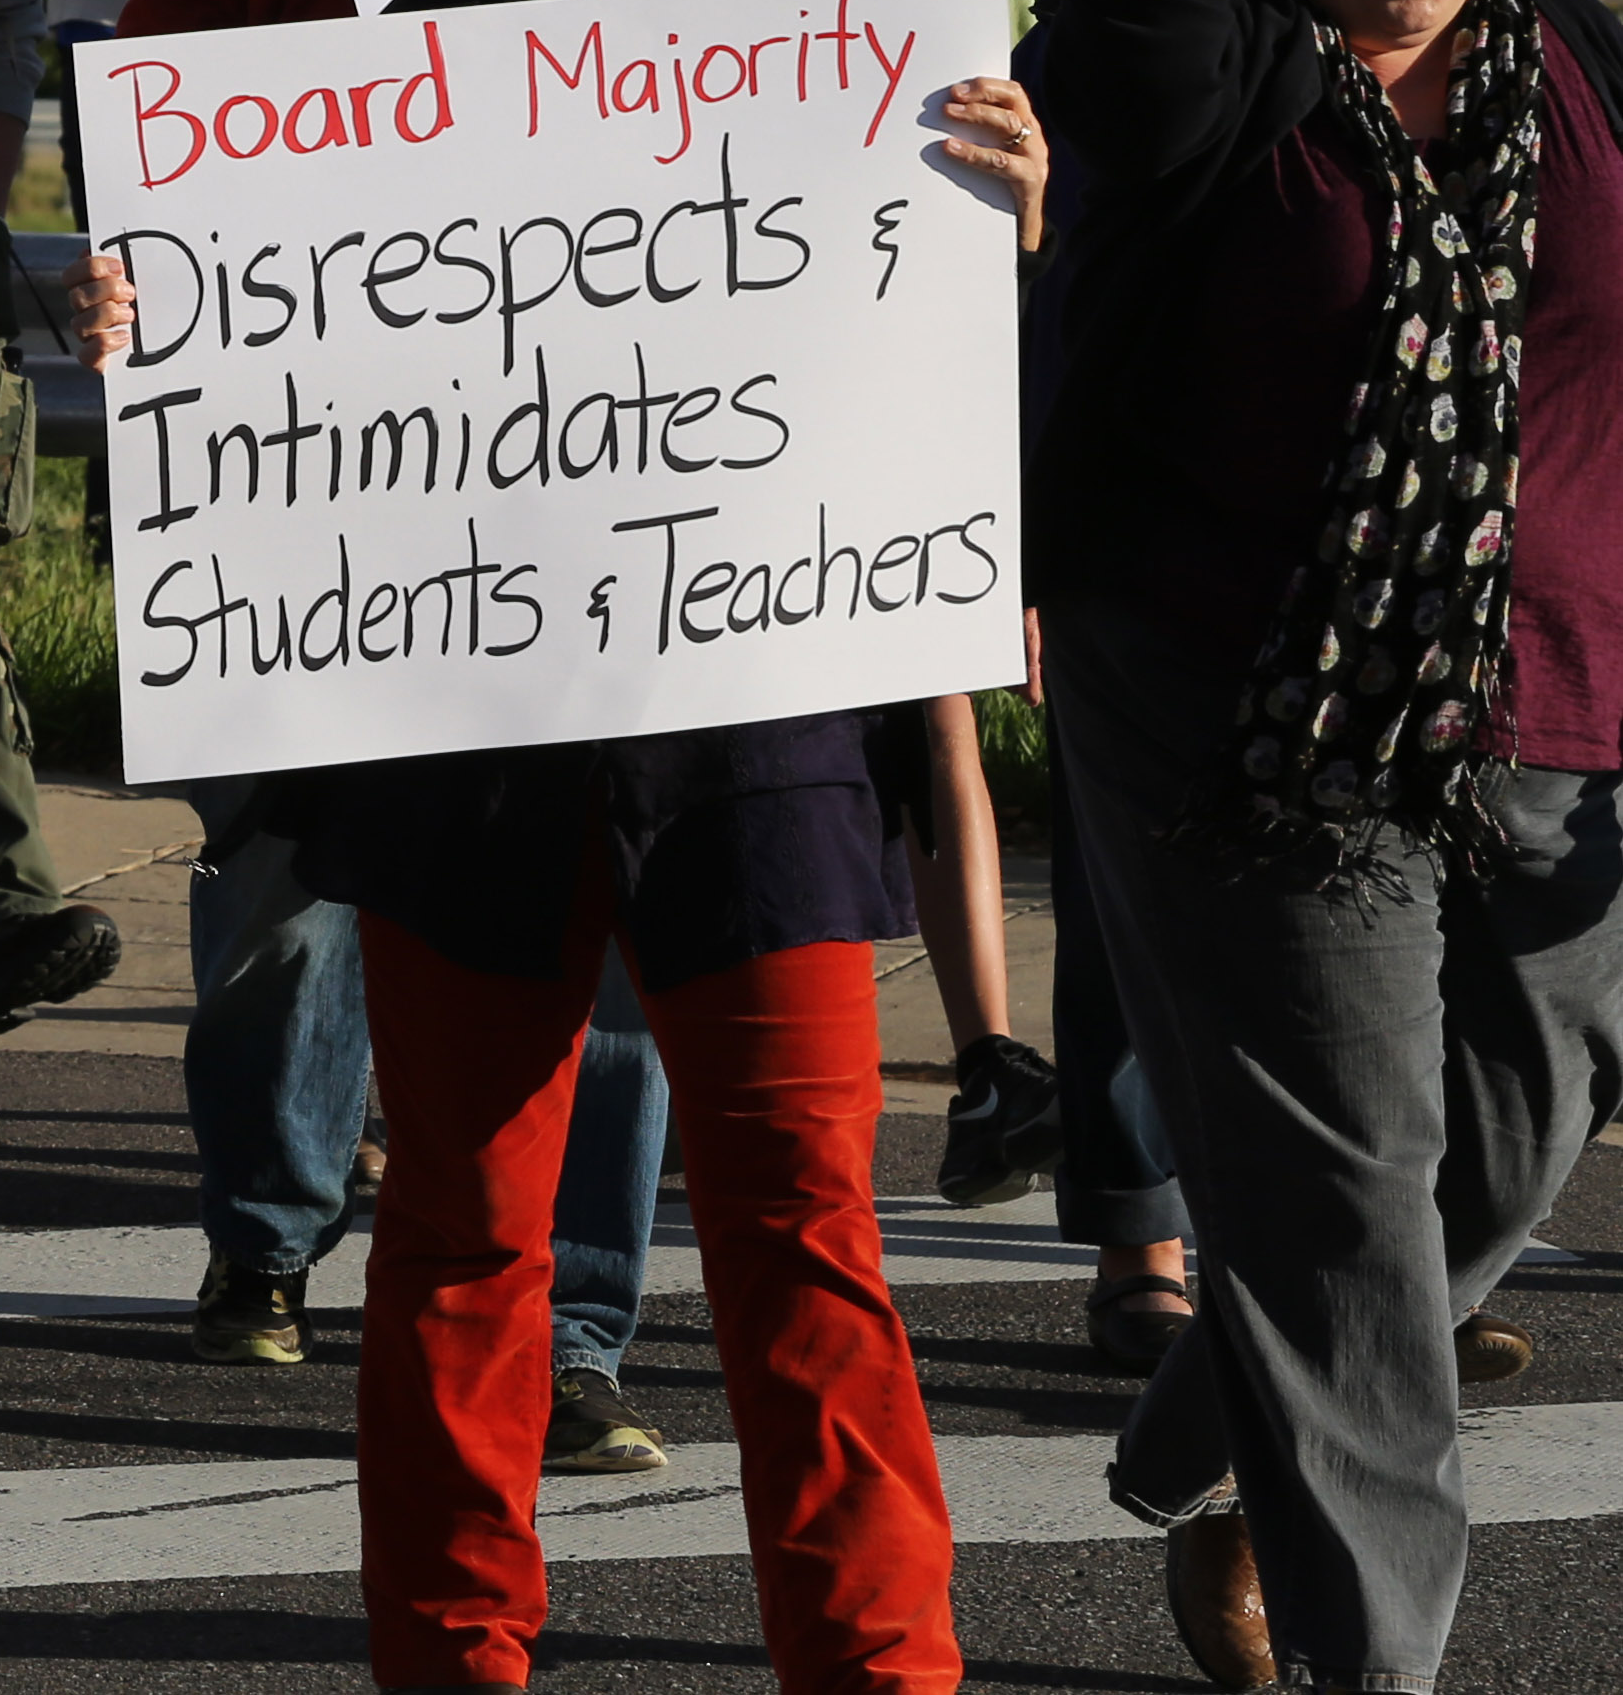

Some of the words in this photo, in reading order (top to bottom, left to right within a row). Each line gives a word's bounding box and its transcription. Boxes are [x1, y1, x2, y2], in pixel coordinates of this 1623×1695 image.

[106, 19, 455, 190] Board
[99, 131, 812, 376] Disrespects
[119, 341, 791, 533] Intimidates
[140, 516, 545, 689] Students
[611, 501, 1000, 657] Teachers
